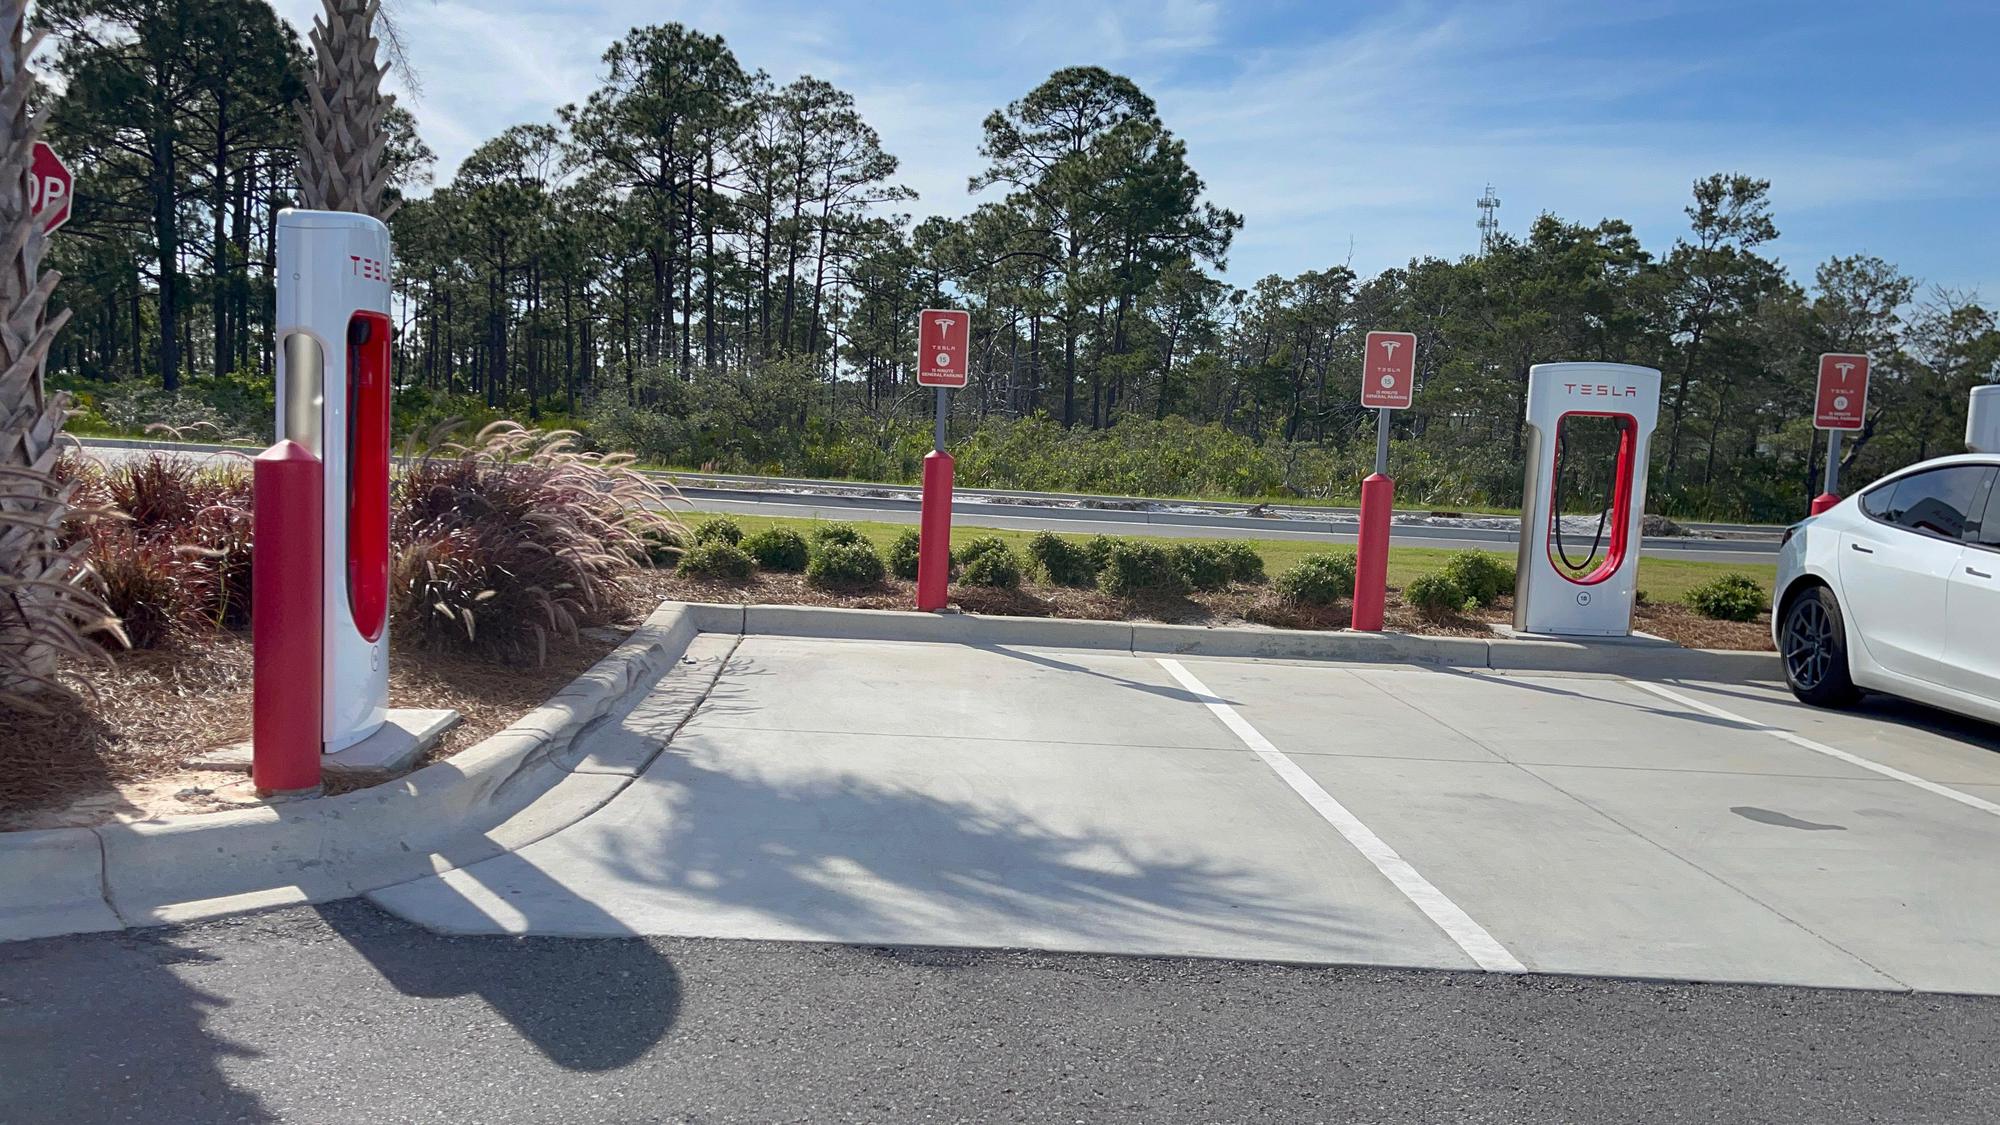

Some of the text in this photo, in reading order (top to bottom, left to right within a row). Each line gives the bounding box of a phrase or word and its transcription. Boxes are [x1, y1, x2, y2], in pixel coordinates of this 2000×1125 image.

[28, 173, 65, 209] OP
[350, 255, 388, 283] TESL
[1564, 383, 1636, 398] TESLA
